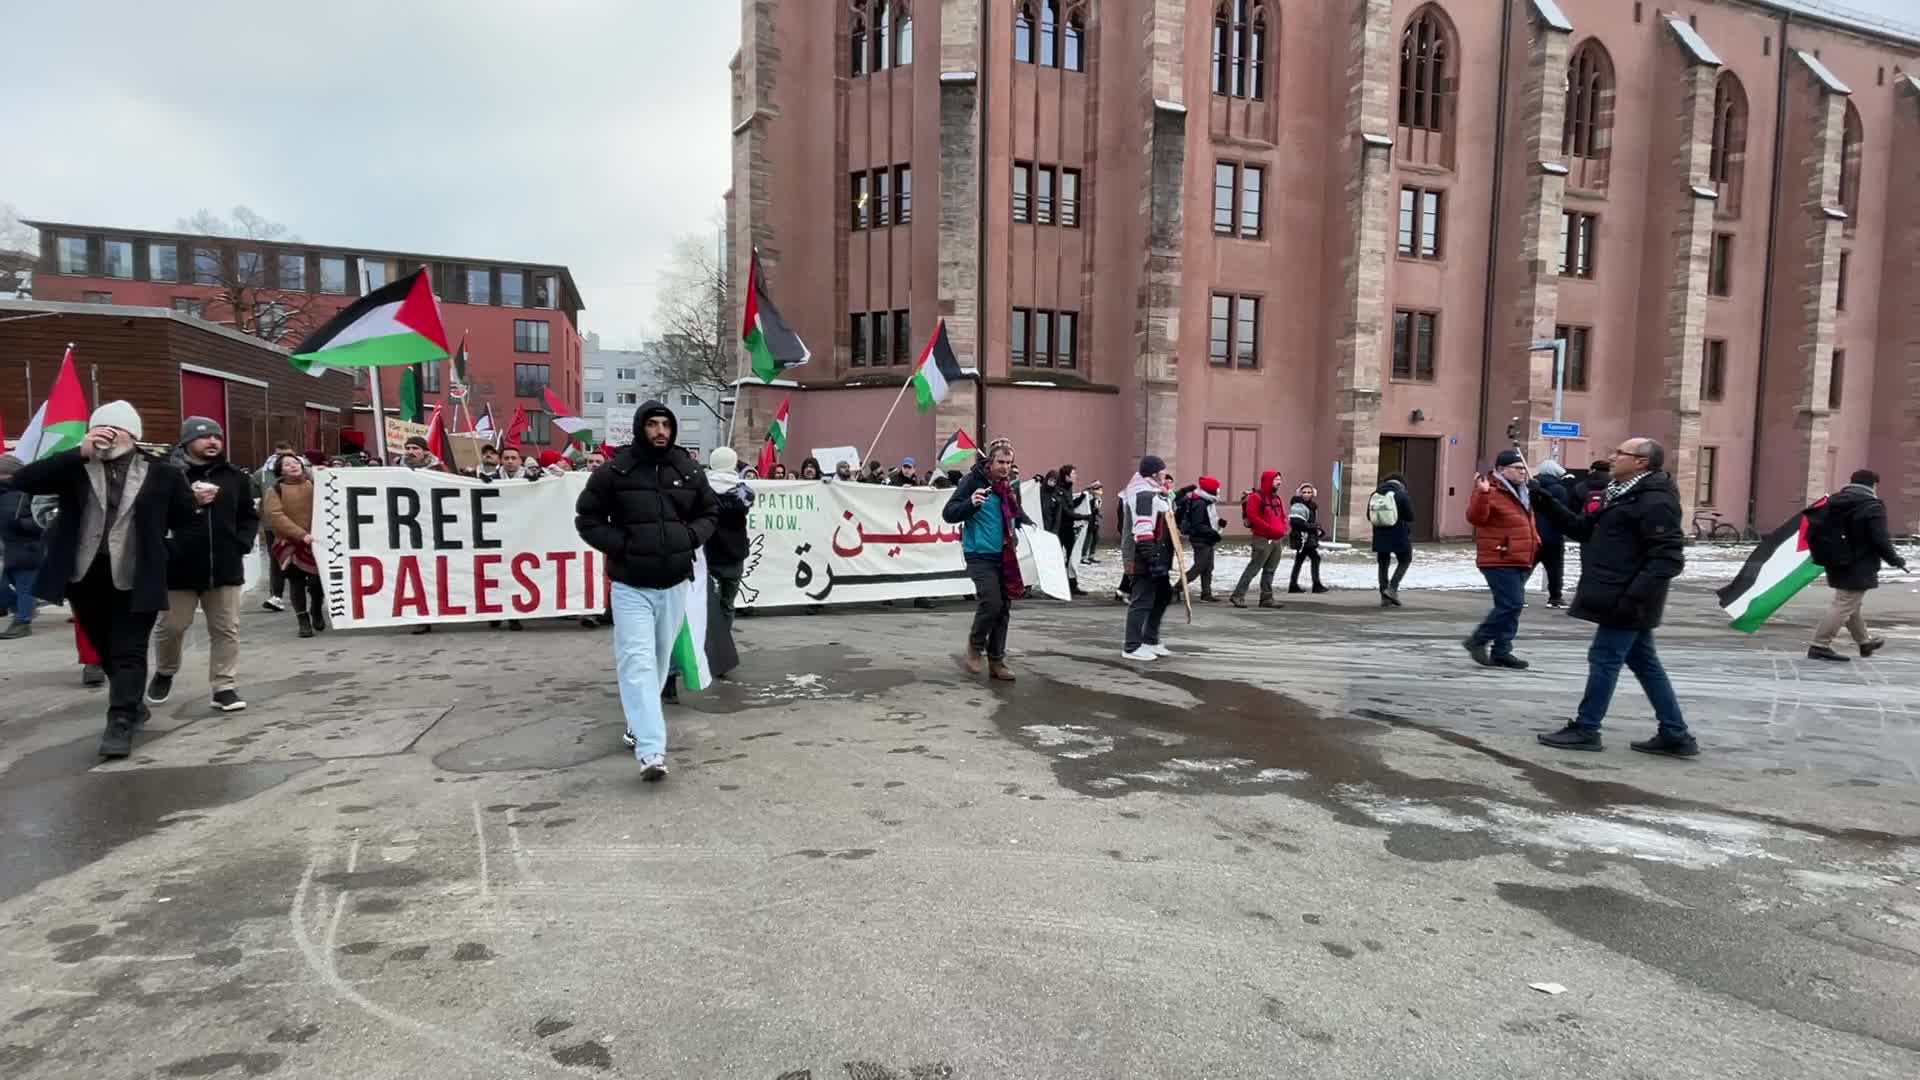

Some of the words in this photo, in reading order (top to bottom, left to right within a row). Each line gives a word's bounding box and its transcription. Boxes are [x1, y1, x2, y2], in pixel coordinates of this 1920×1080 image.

[346, 487, 502, 549] FREE
[758, 493, 820, 512] PATION,
[765, 514, 801, 530] NOW.
[832, 500, 963, 557] سطين
